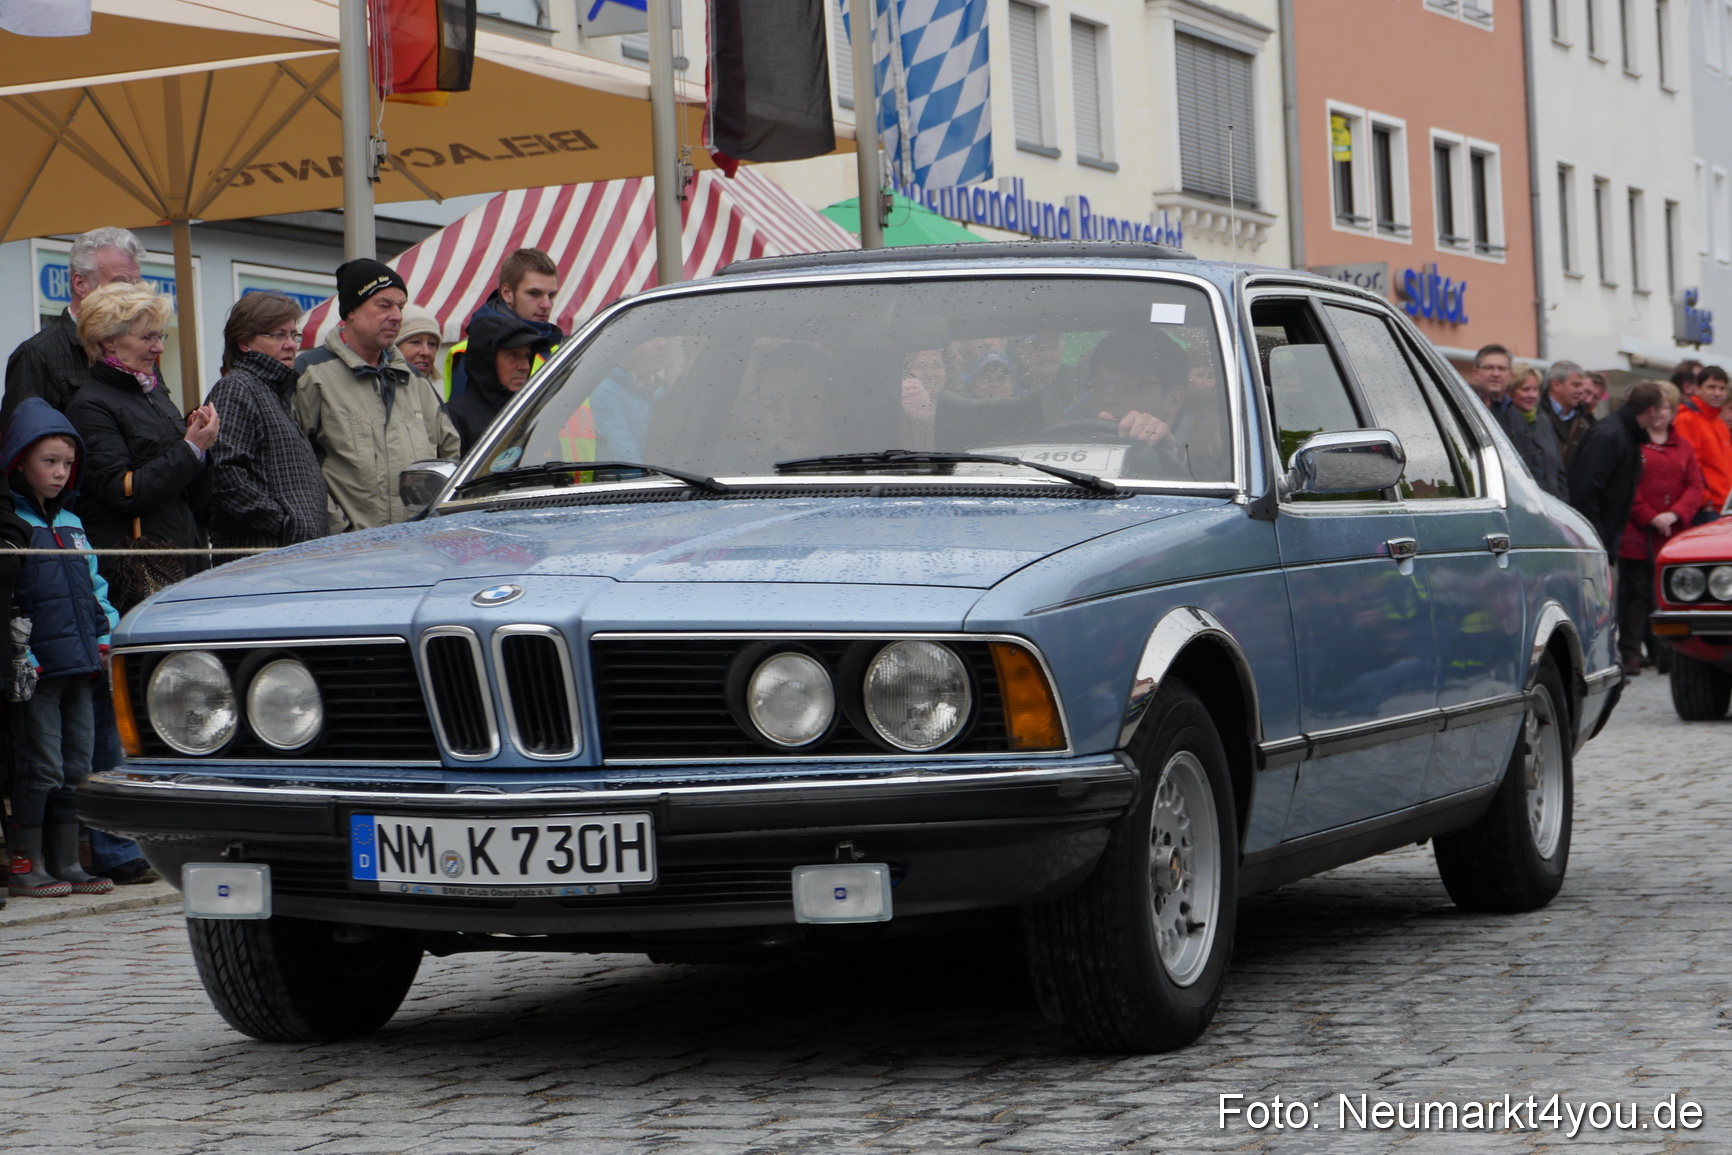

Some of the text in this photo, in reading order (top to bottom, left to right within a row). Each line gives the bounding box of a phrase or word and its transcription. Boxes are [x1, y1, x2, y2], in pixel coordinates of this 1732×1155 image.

[1033, 451, 1088, 462] 466
[377, 821, 647, 875] NM K 730H
[358, 854, 371, 868] D
[467, 888, 490, 896] Club
